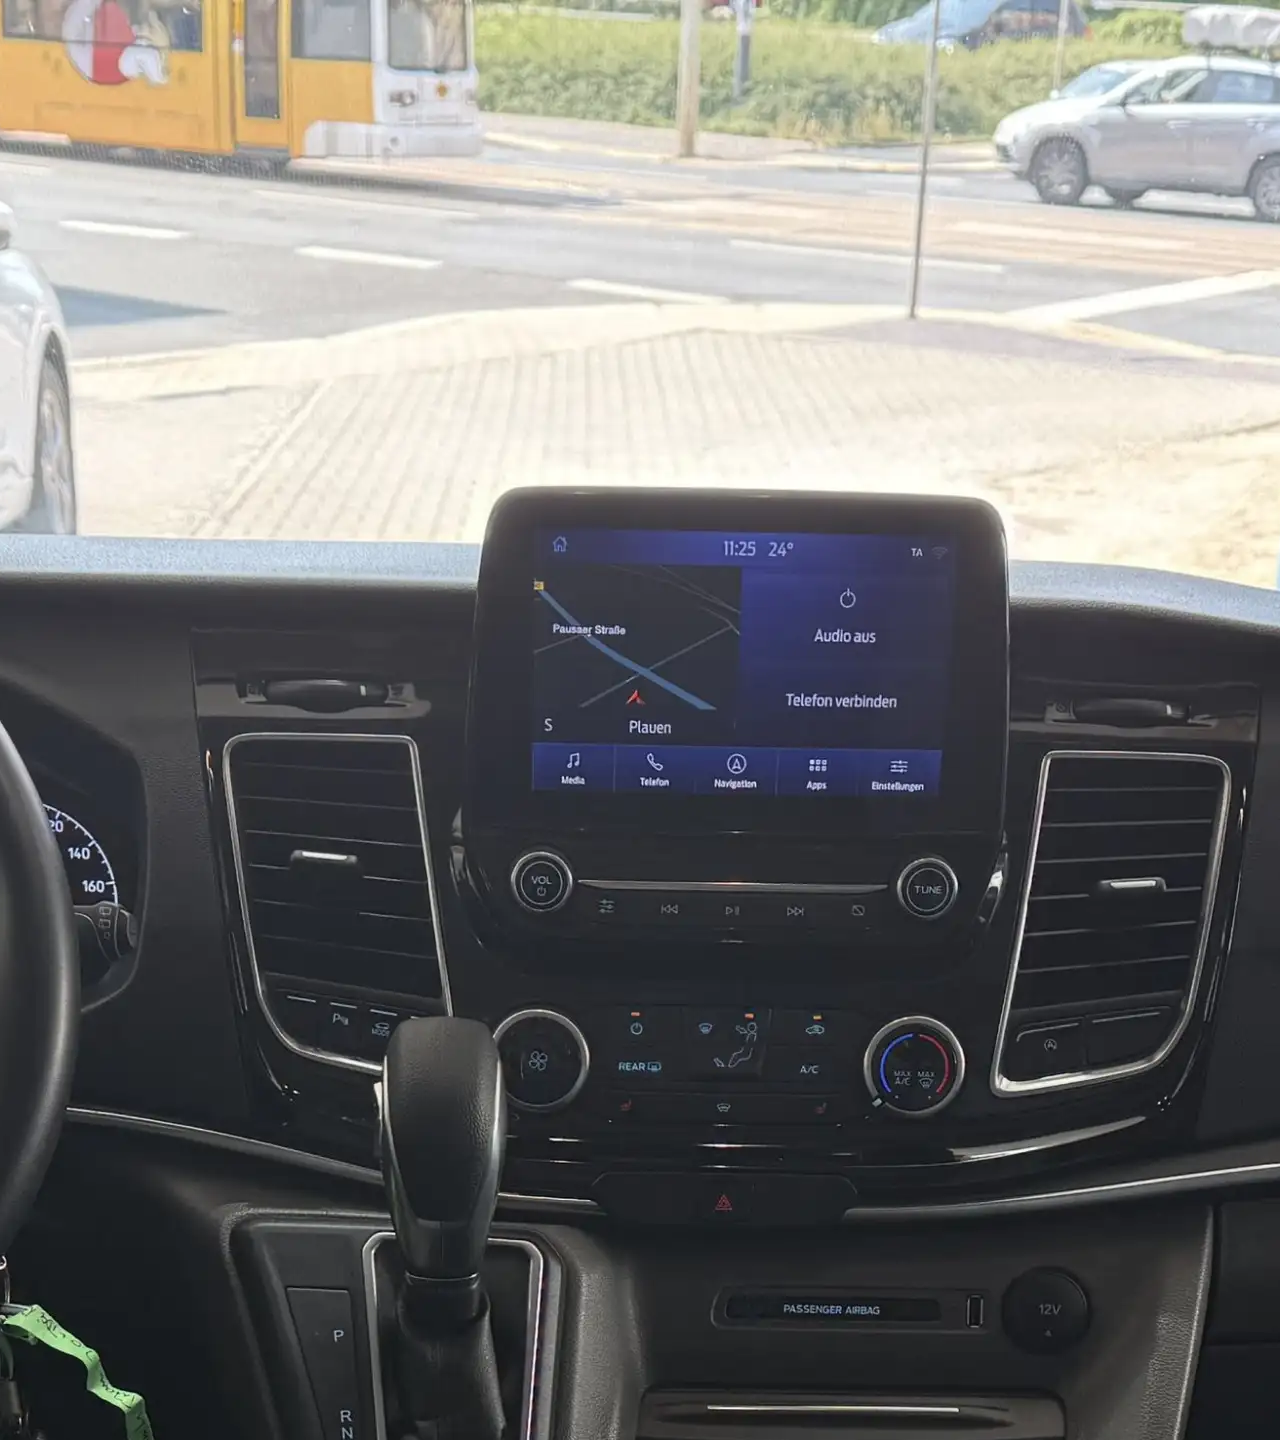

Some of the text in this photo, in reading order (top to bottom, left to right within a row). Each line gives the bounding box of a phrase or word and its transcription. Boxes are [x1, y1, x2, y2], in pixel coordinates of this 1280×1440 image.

[723, 540, 794, 557] 11:25 24°
[911, 547, 923, 557] TA
[552, 623, 626, 637] Pausaer Straße
[814, 628, 876, 644] Audio aus
[785, 693, 897, 709] Telefon verbinden
[628, 720, 671, 735] Plauen
[561, 775, 585, 786] Media
[640, 776, 669, 788] Telefon
[714, 778, 757, 790] Navigation
[806, 781, 827, 792] Apps
[871, 781, 924, 793] Einstellungen
[67, 847, 91, 860] 140
[81, 879, 105, 893] 160
[531, 875, 552, 885] VOL
[913, 885, 943, 895] TUNE
[618, 1061, 645, 1072] REAR
[799, 1064, 819, 1074] A/C
[893, 1070, 912, 1078] MAX
[917, 1070, 935, 1079] MAX
[894, 1078, 912, 1087] A/C
[783, 1303, 880, 1316] PASSENGER AIRBAG
[1038, 1303, 1062, 1316] 12V
[333, 1329, 344, 1343] P
[340, 1409, 352, 1423] R
[341, 1427, 354, 1440] N
